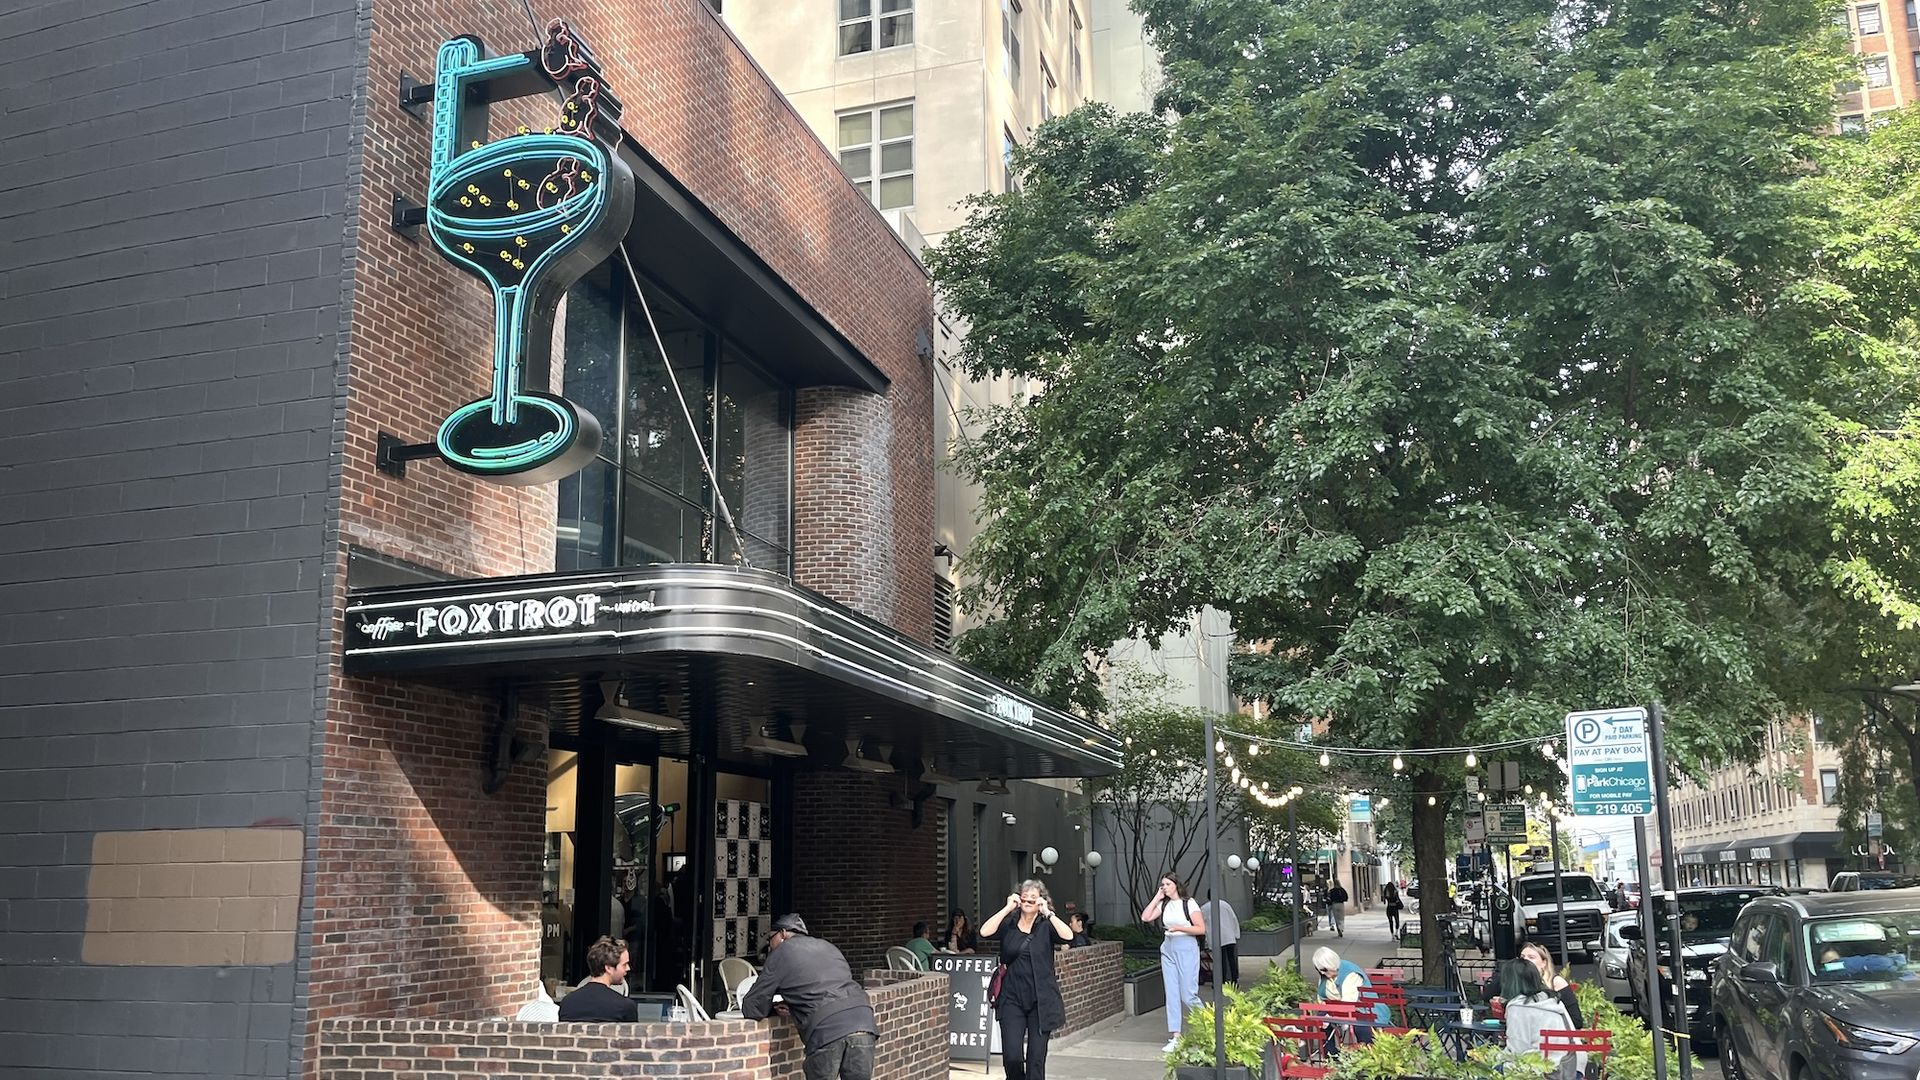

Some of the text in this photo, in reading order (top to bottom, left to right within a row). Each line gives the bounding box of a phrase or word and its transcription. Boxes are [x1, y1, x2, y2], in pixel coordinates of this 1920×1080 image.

[361, 616, 404, 640] coffee
[417, 594, 601, 638] FOXTROT
[1604, 747, 1621, 755] PAY
[1623, 746, 1643, 754] BOX
[1587, 776, 1646, 788] ParkChicago
[1595, 804, 1618, 814] 219
[1620, 803, 1644, 814] 405
[934, 959, 992, 972] COFFEE
[980, 976, 992, 1030] WINE
[950, 1032, 987, 1046] RKET
